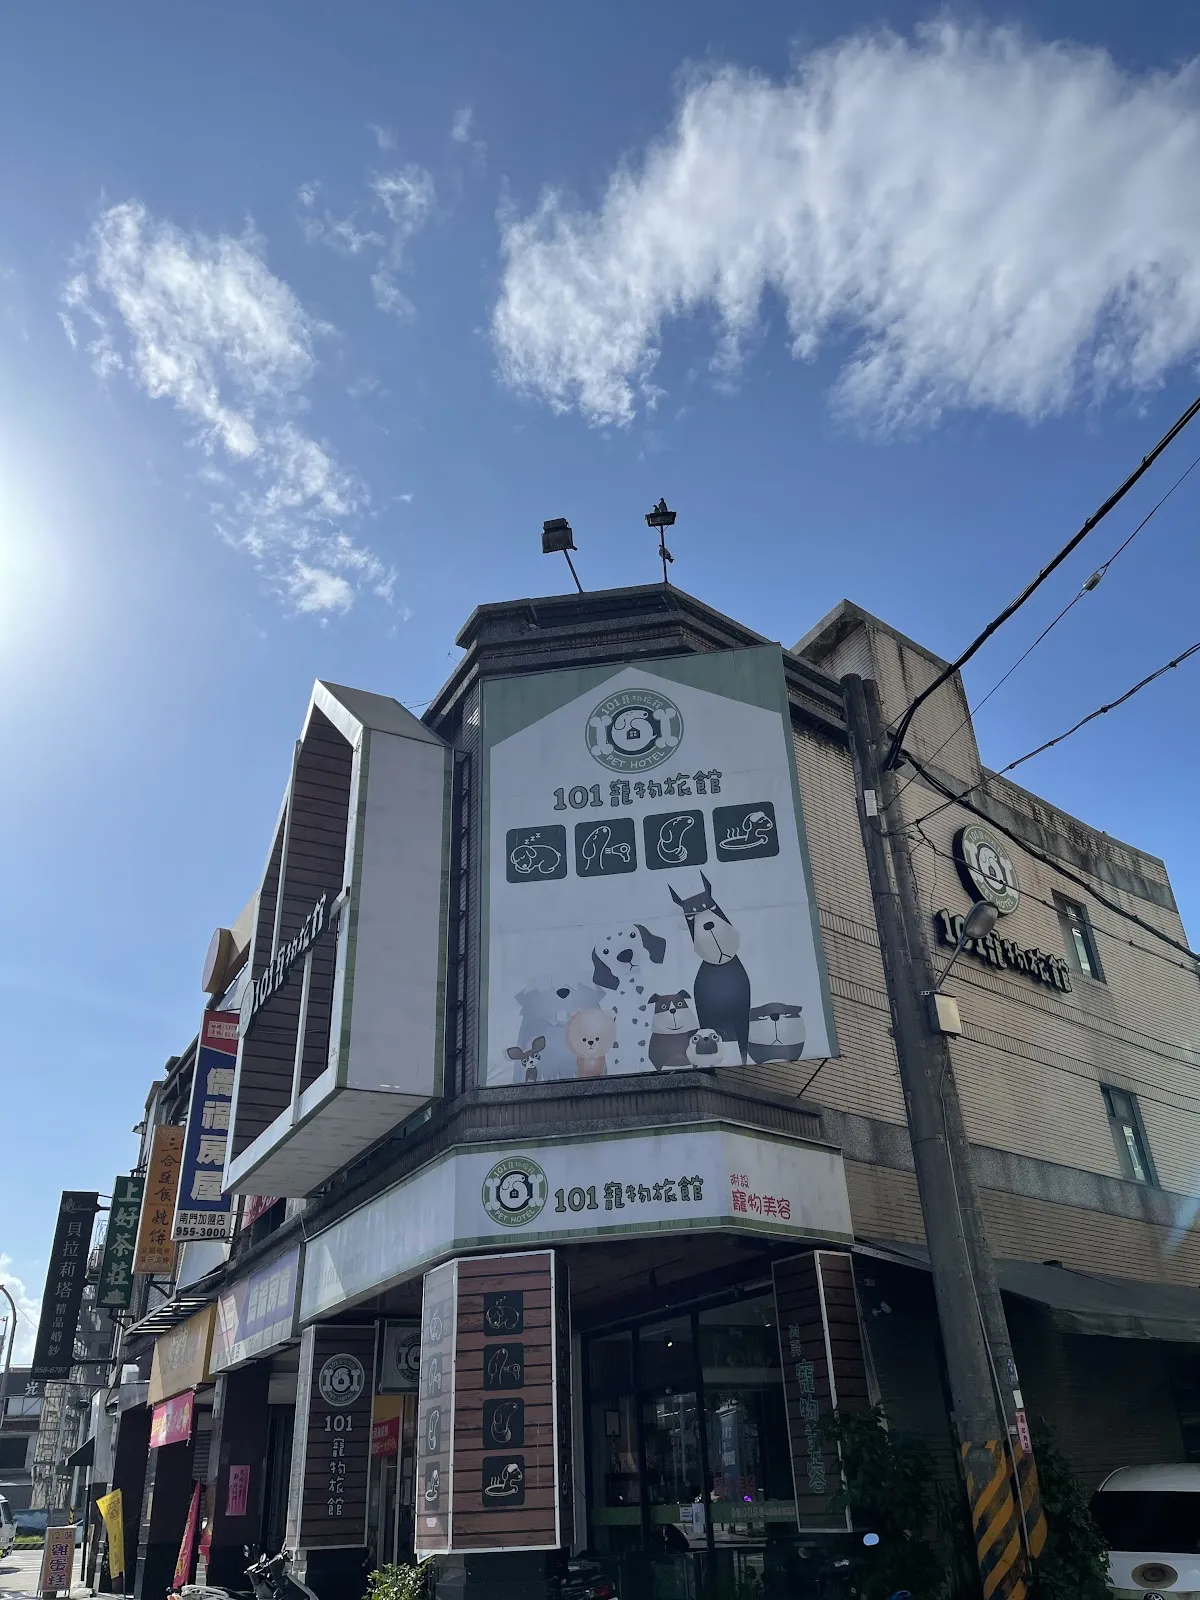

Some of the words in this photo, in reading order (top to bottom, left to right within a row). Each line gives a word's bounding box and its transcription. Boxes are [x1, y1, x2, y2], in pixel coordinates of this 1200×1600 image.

[606, 754, 626, 768] PET
[630, 751, 665, 769] HOTEL
[494, 1210, 508, 1221] PET
[510, 1208, 535, 1223] HOTEL
[731, 1189, 791, 1220] 寵物美容
[179, 1212, 226, 1226] 南門加盟店
[176, 1226, 226, 1237] 955-3000
[55, 1221, 83, 1299] 貝拉莉塔
[47, 1302, 67, 1358] 精品婚紗
[325, 1415, 353, 1432] 101
[327, 1437, 347, 1516] 寵物旅館
[46, 1543, 70, 1587] 雞蛋糕
